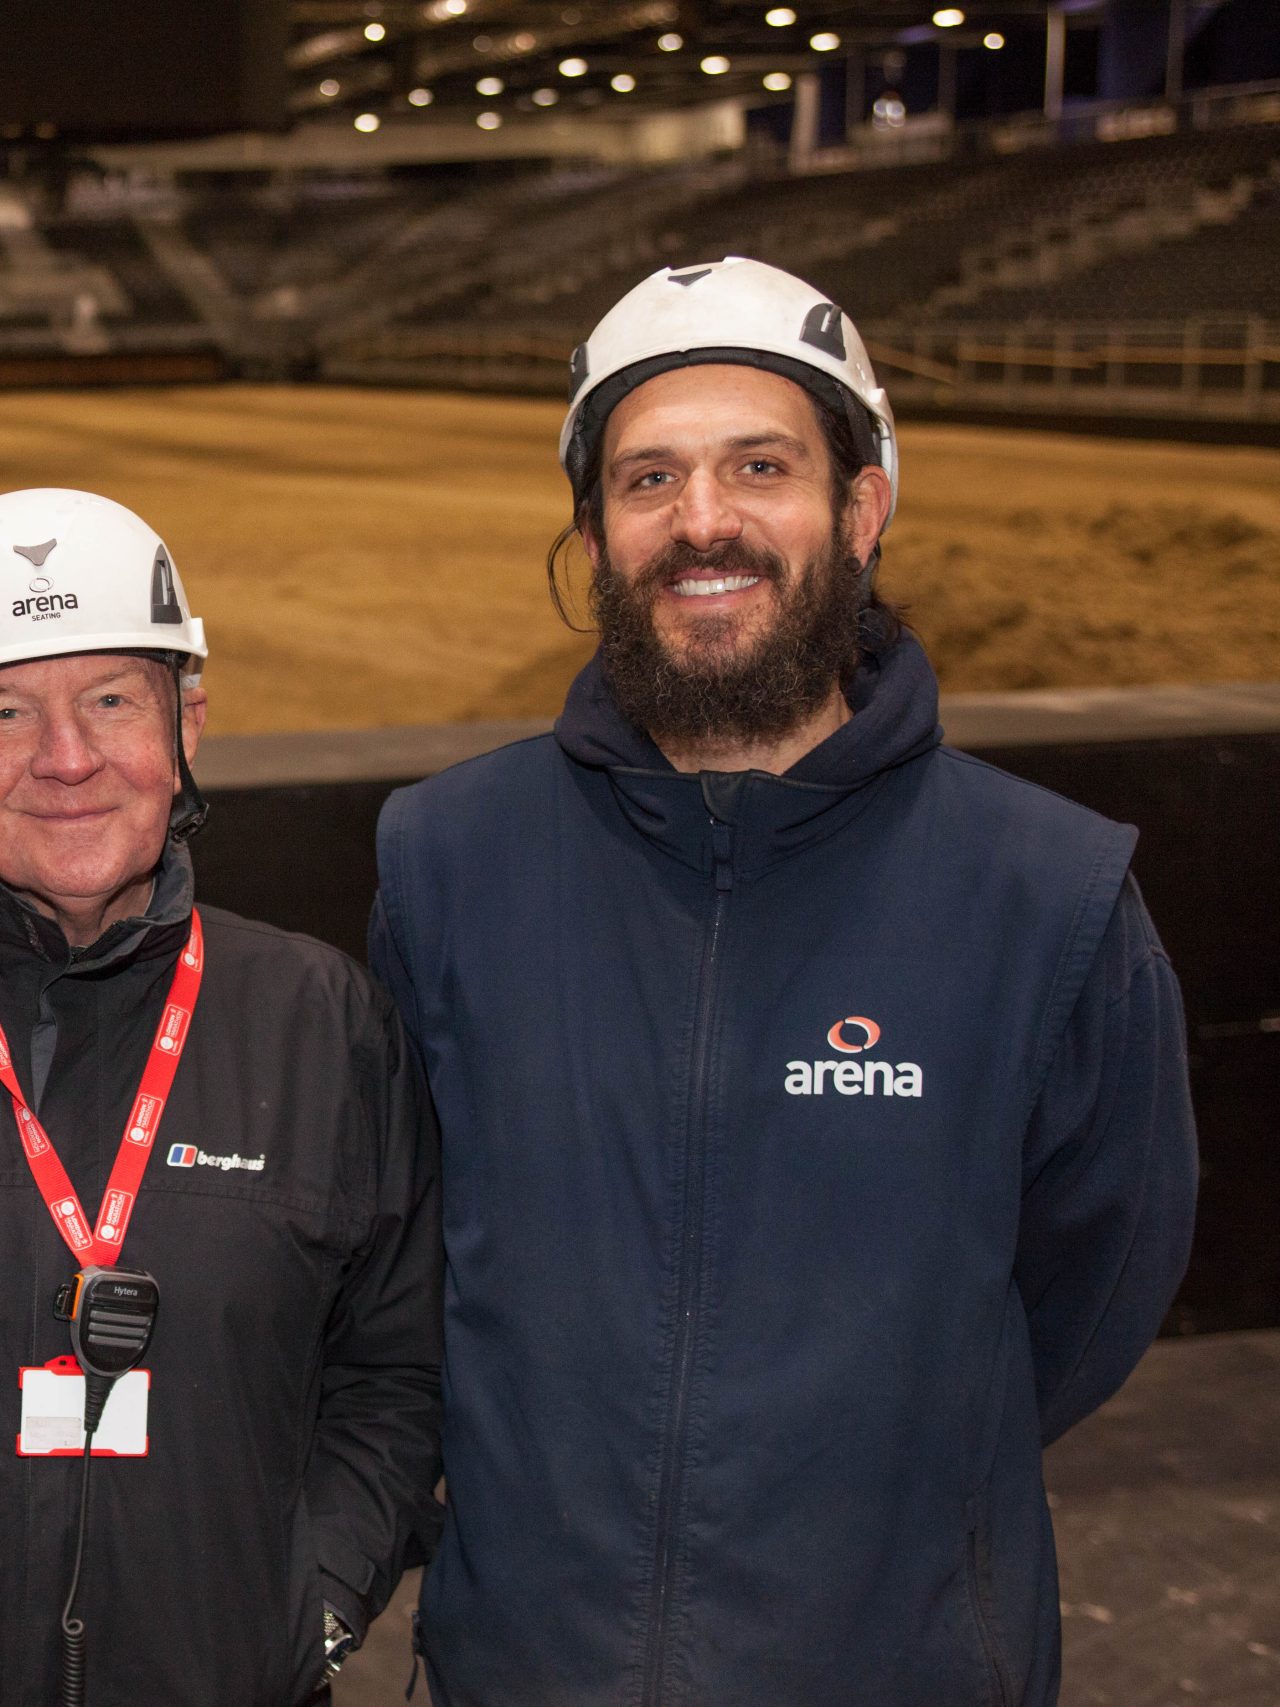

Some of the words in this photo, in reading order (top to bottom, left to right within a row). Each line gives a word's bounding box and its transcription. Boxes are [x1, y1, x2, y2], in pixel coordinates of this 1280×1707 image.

[12, 593, 79, 617] arena
[31, 612, 61, 622] SEATING
[784, 1060, 923, 1098] arena
[197, 1151, 266, 1171] berghaus
[114, 1286, 138, 1297] Hytera
